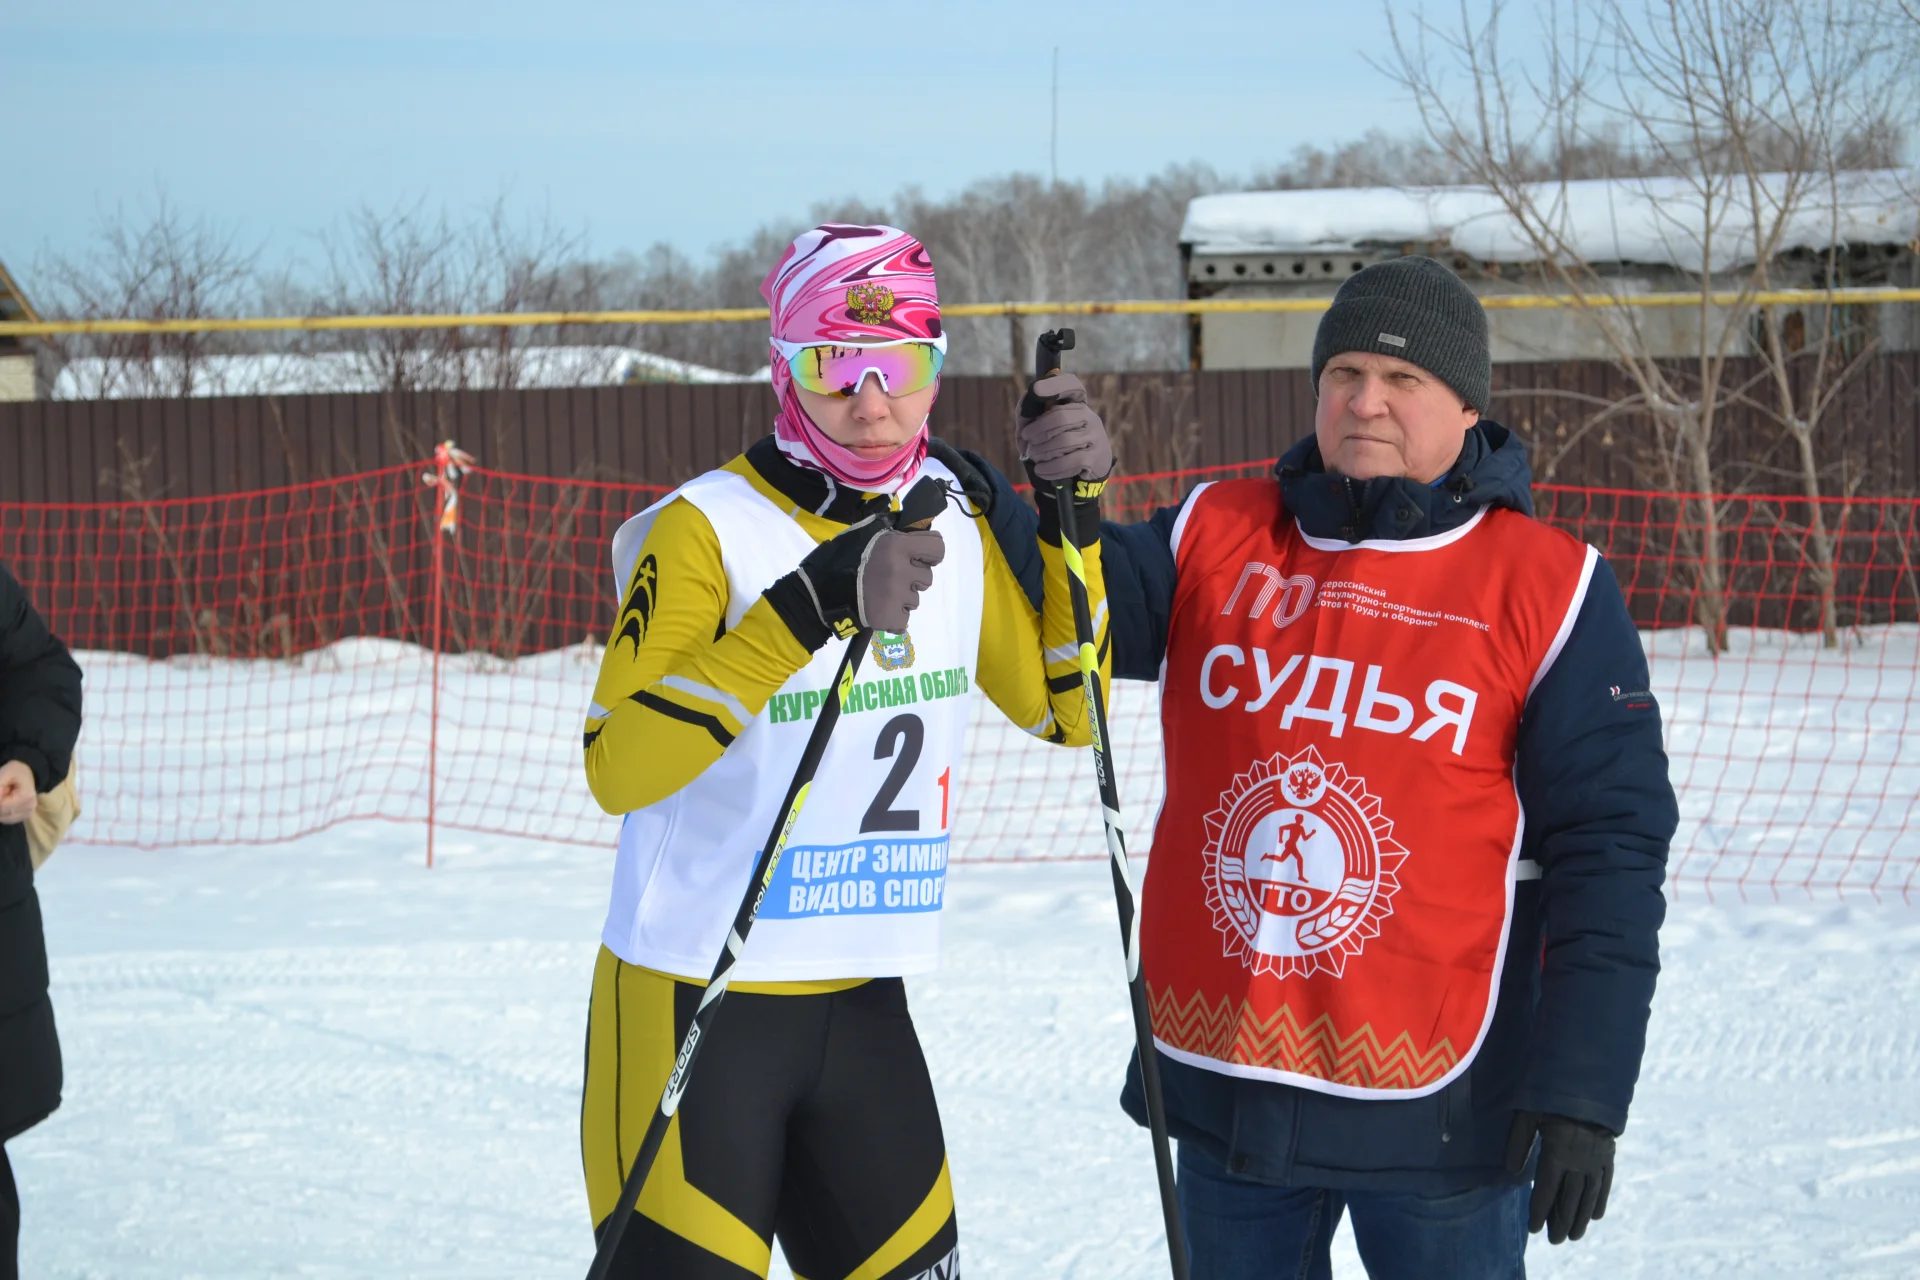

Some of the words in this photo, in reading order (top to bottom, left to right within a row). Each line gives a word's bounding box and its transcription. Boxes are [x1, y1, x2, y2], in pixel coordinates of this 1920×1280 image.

[1321, 580, 1387, 598] сероссийский
[1343, 601, 1349, 609] к
[1352, 603, 1380, 619] труду
[1382, 611, 1388, 619] и
[1391, 611, 1438, 628] обороне»
[1444, 612, 1490, 632] комплекс
[1199, 643, 1479, 757] СУДЬЯ
[859, 712, 925, 835] 2
[791, 846, 867, 883] ЦЕНТР
[788, 879, 877, 914] ВИДОВ
[1259, 882, 1313, 912] ГТО
[669, 1023, 699, 1100] SPORT
